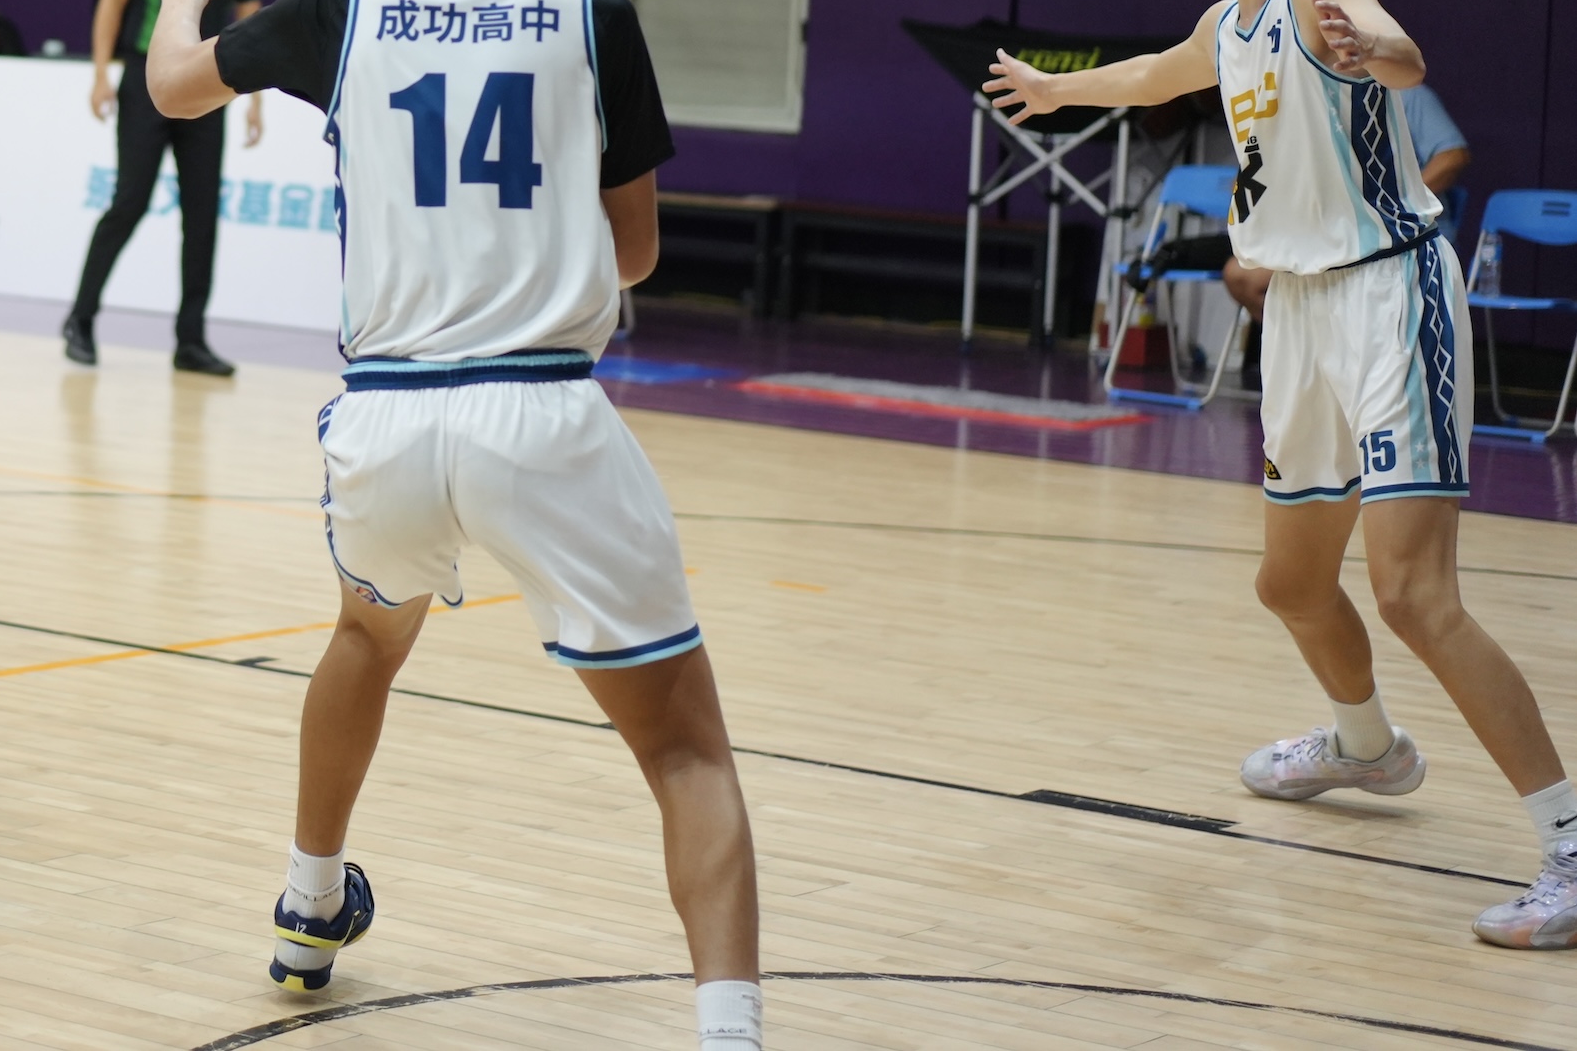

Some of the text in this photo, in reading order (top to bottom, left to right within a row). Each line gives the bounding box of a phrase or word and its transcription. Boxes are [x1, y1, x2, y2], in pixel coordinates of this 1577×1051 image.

[376, 0, 560, 43] 成功高中
[389, 72, 542, 209] 14
[1359, 430, 1397, 475] 15
